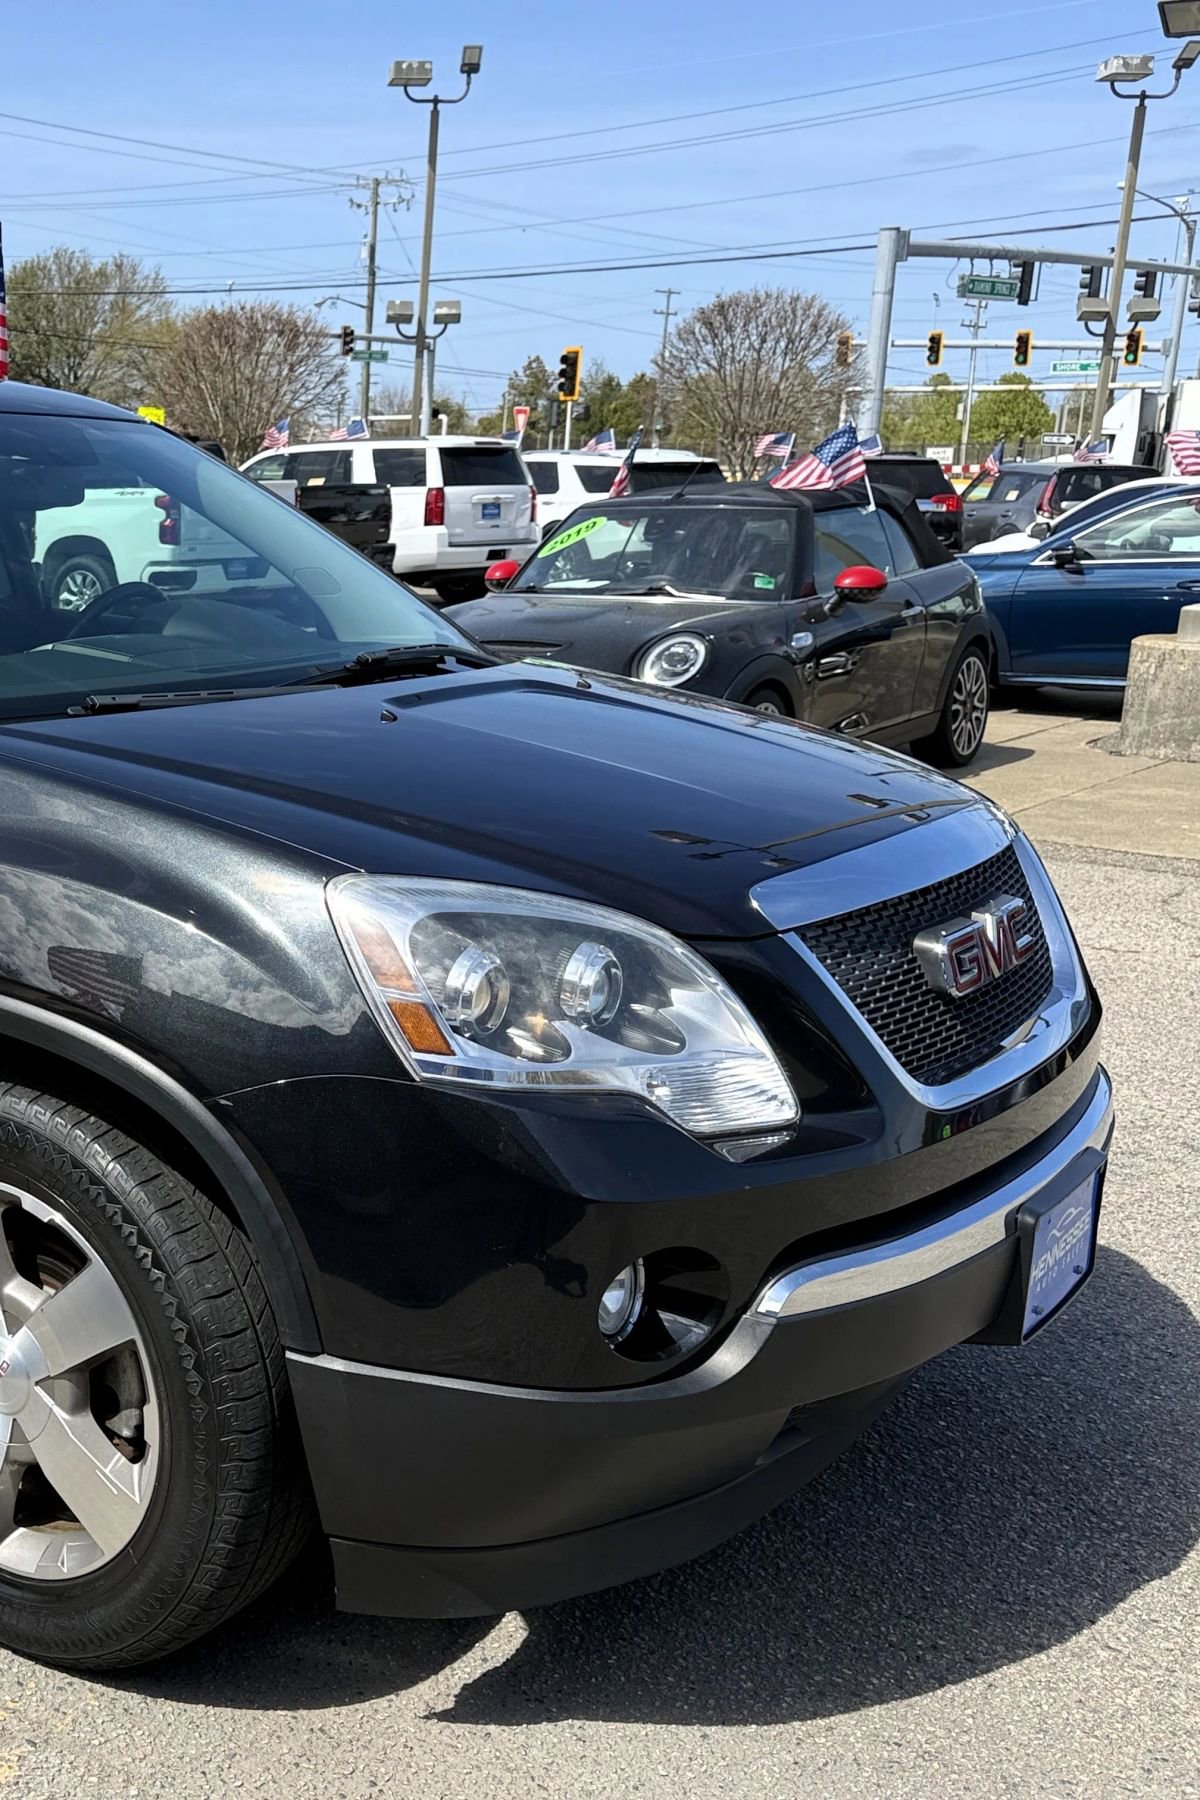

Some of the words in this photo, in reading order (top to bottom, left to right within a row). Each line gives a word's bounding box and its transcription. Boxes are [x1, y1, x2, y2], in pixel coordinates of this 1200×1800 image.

[1055, 362, 1080, 371] SHORE
[547, 521, 597, 552] 2019
[940, 896, 1036, 998] GMC
[1031, 1208, 1092, 1286] HENNESSEE
[1036, 1265, 1058, 1292] AUTO
[1062, 1237, 1085, 1269] SALES
